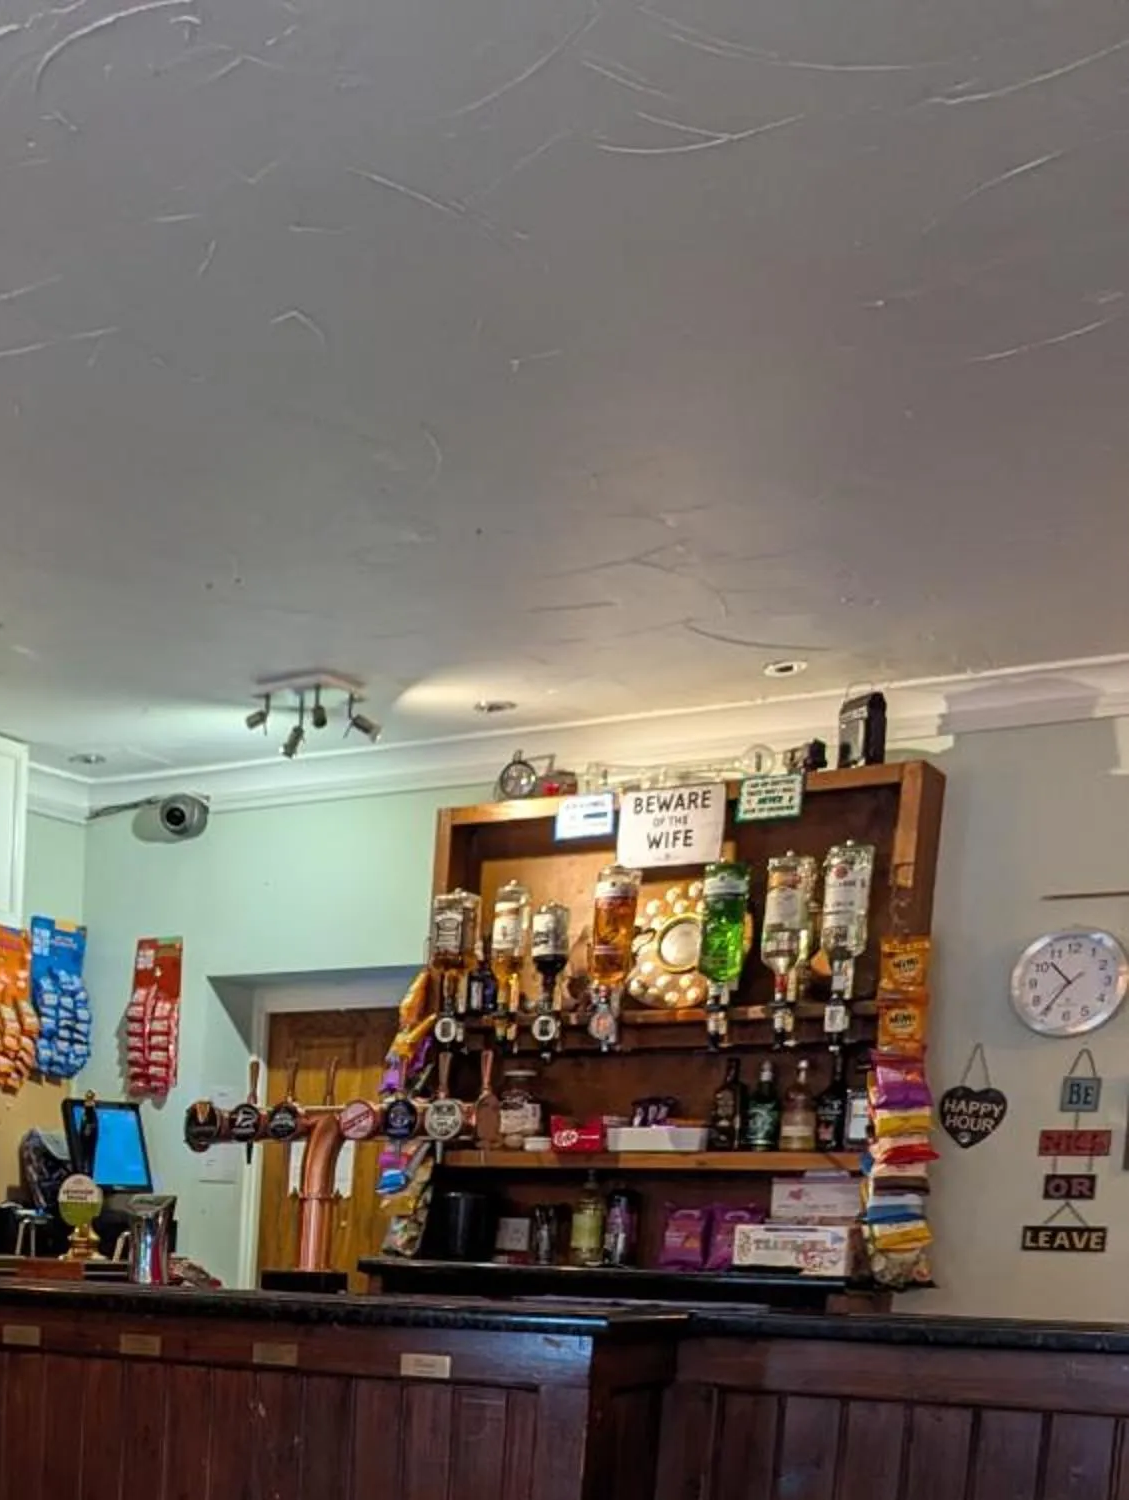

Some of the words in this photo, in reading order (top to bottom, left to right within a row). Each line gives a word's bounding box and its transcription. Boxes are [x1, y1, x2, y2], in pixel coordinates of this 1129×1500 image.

[633, 790, 712, 814] BEWARE
[653, 818, 665, 828] OF
[670, 816, 688, 827] THE
[647, 829, 694, 850] WIFE
[1051, 949, 1063, 959] 11
[1068, 943, 1083, 954] 12
[1034, 961, 1049, 973] 10
[1067, 1083, 1094, 1106] BE
[943, 1099, 1004, 1118] HAPPY
[944, 1114, 996, 1132] HOUR
[1047, 1179, 1091, 1197] OR
[1024, 1230, 1105, 1250] LEAVE
